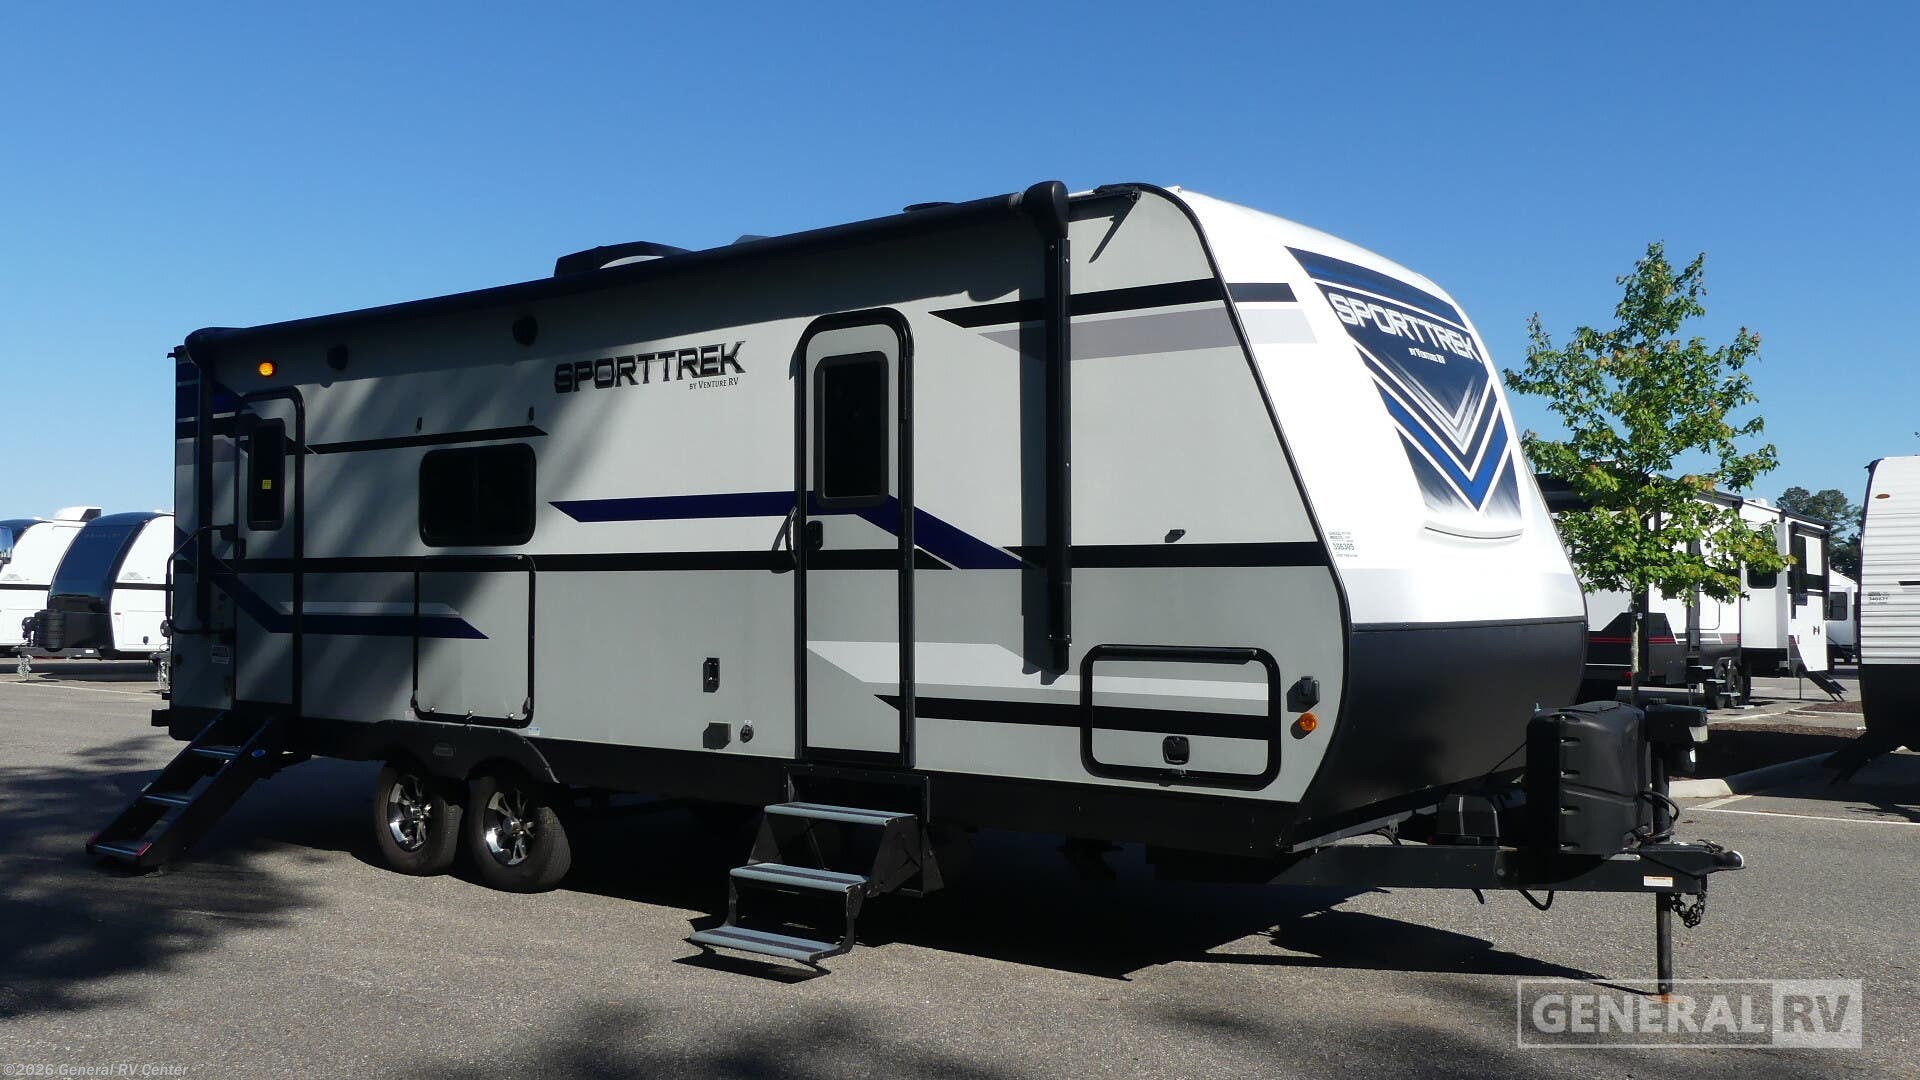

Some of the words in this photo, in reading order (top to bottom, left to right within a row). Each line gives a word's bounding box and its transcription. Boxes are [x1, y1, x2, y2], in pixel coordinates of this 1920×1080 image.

[1328, 292, 1482, 363] SPORTTREK
[554, 340, 746, 394] SPORTTREK
[728, 377, 739, 386] RV
